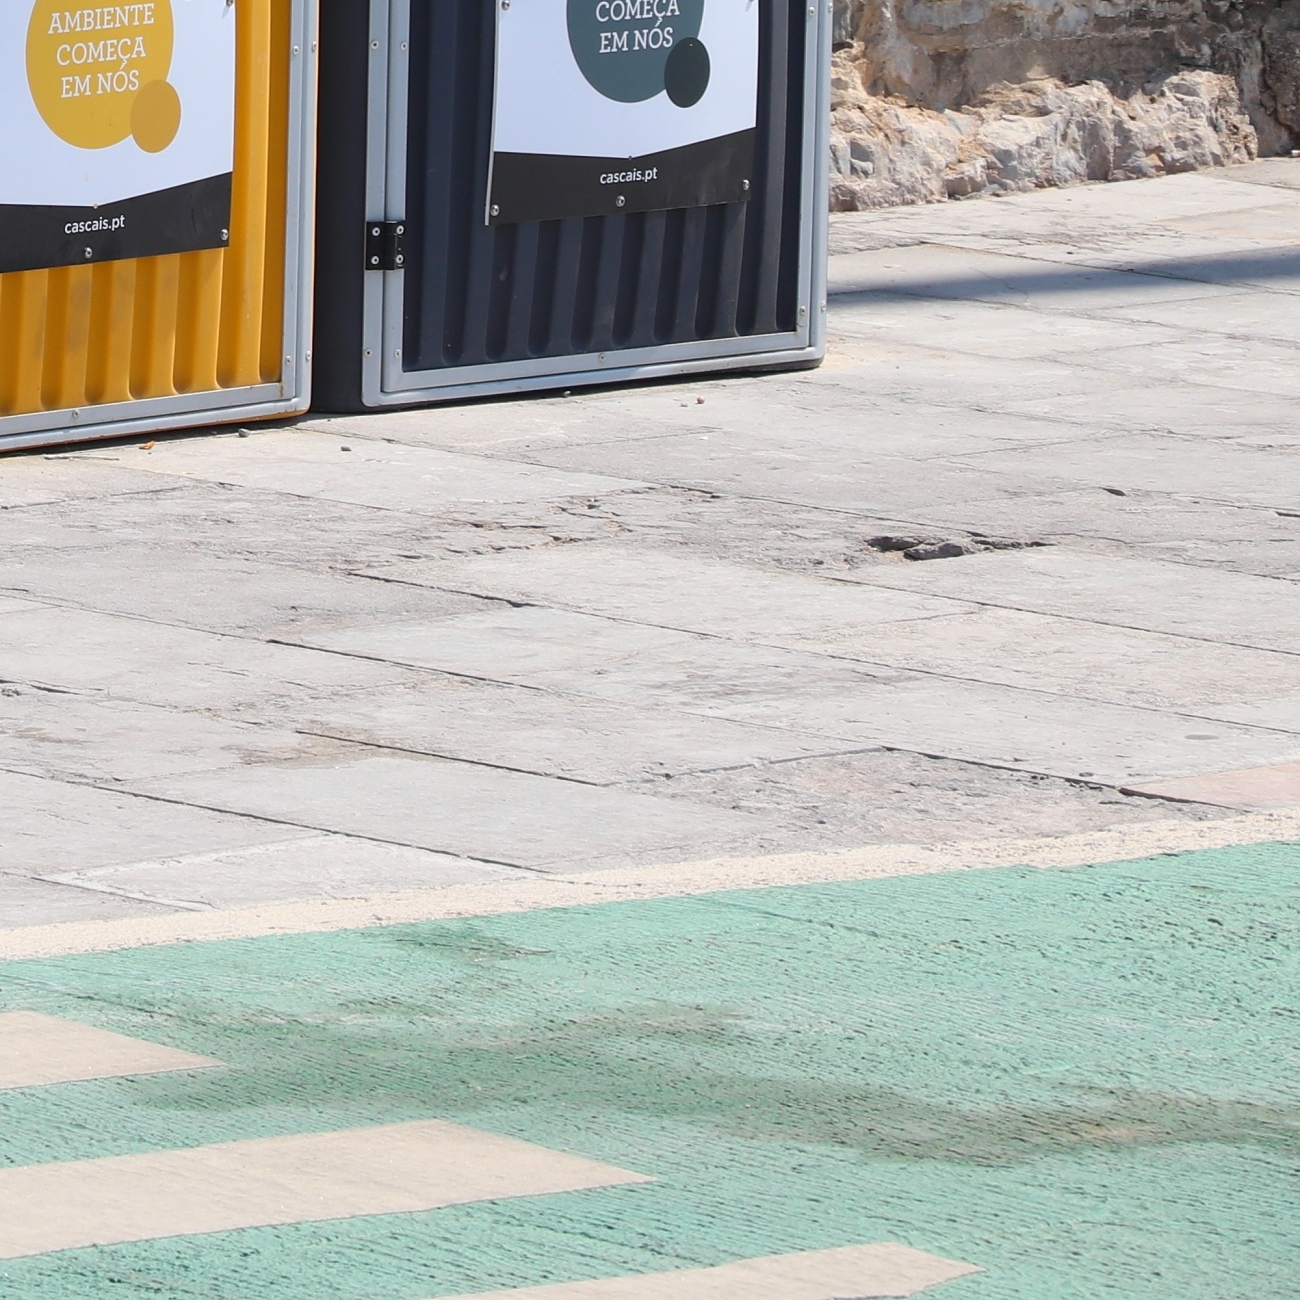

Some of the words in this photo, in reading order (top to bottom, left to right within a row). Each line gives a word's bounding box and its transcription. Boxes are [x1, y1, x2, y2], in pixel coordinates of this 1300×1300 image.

[47, 2, 155, 35] AMBIENTE
[56, 36, 147, 66] COMEÇA
[599, 31, 629, 54] EM
[633, 19, 674, 51] NÓS
[60, 75, 92, 98] EM
[96, 62, 139, 94] NÓS
[599, 167, 658, 185] cascais.pt
[64, 214, 125, 234] cascais.pt
